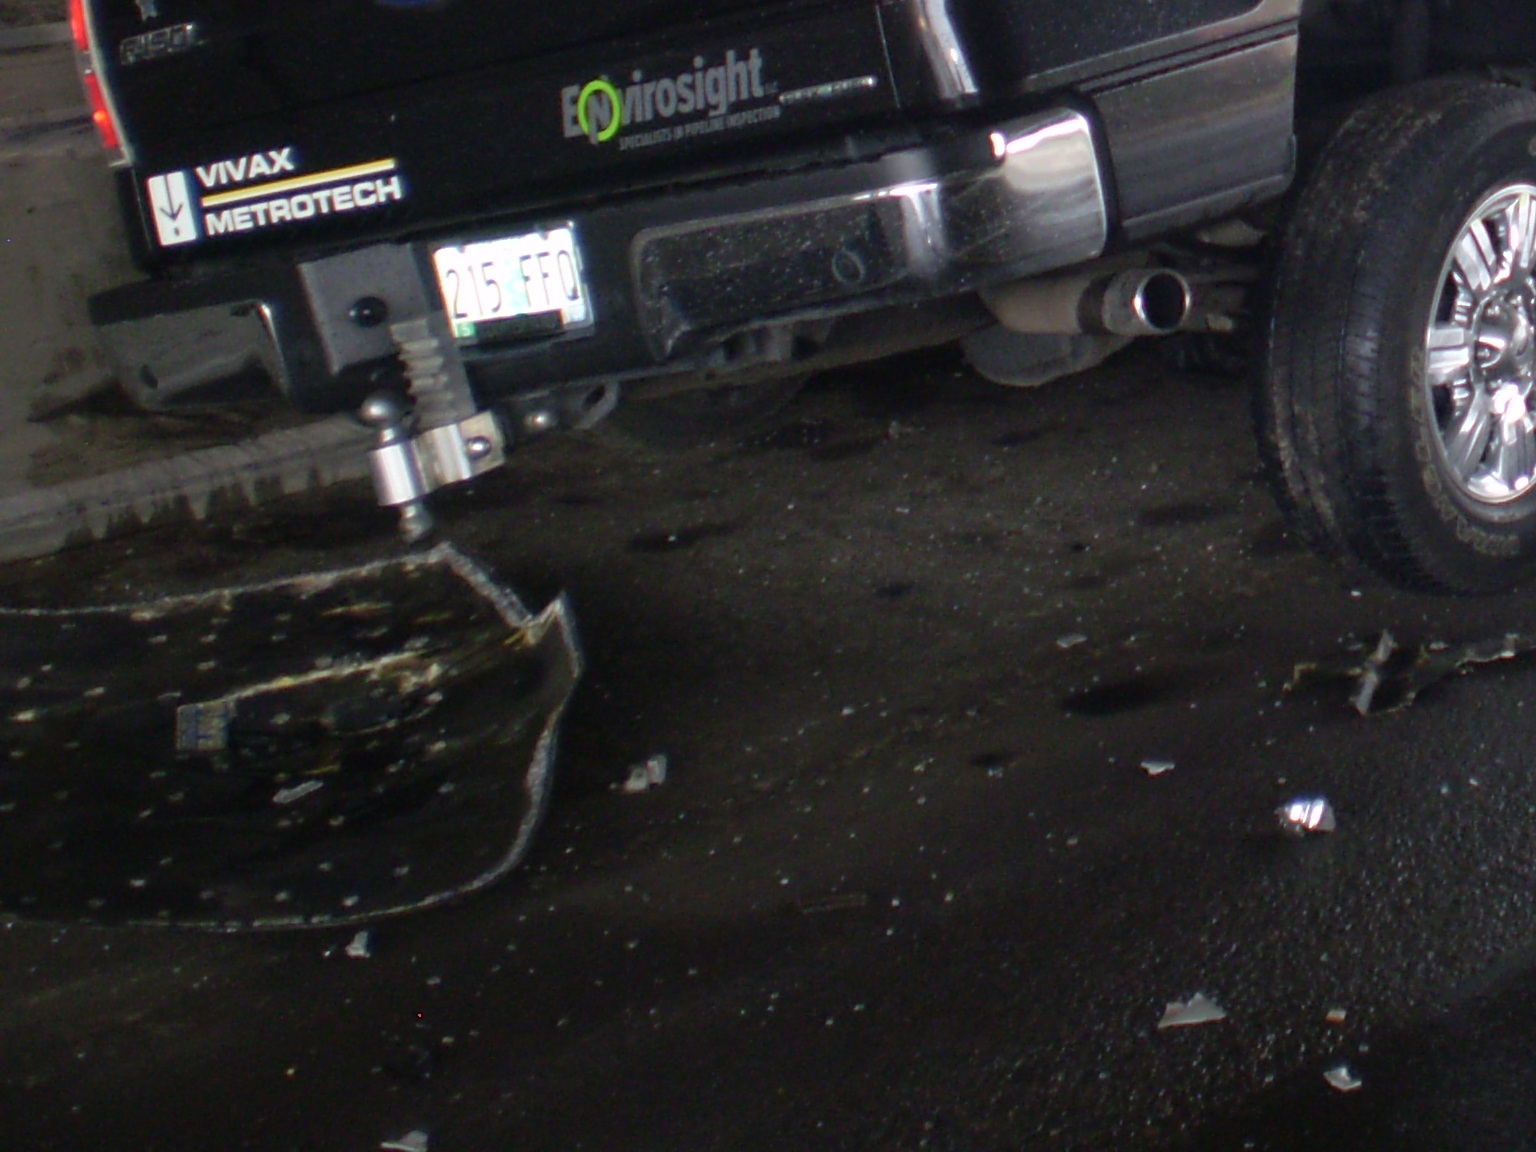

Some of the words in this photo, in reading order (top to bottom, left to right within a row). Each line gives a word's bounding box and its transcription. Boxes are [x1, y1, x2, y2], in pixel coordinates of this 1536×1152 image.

[196, 147, 295, 188] VIVAX
[204, 176, 402, 236] METROTECH
[446, 261, 502, 320] 215
